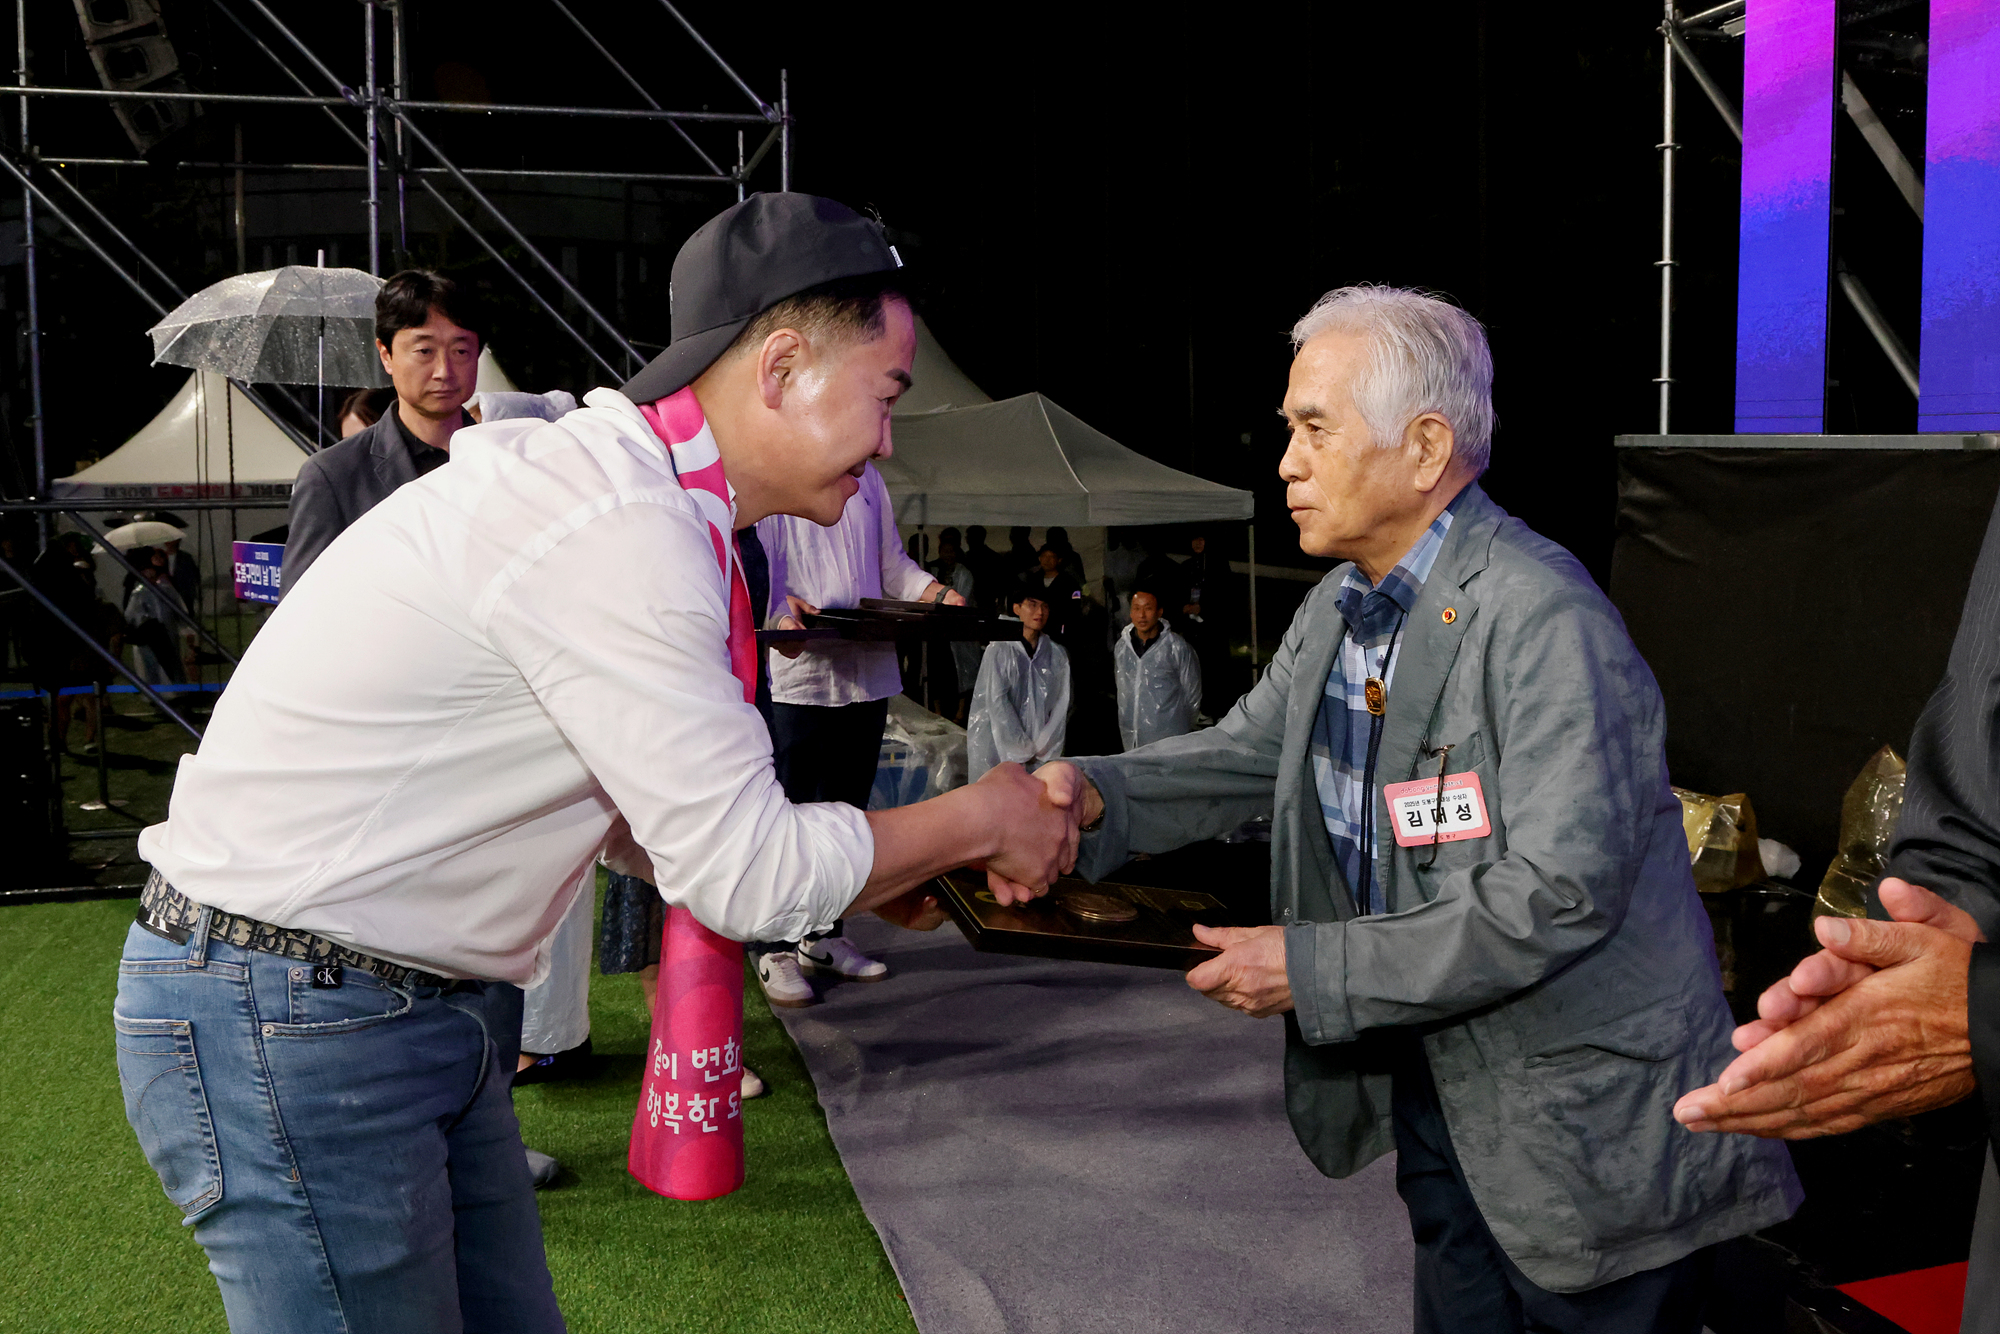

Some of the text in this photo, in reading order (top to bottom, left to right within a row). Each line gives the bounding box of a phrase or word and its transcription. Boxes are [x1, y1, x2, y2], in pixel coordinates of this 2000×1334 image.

[235, 562, 262, 586] 도봉구민의
[262, 565, 269, 586] 날
[1422, 795, 1451, 806] 도봉구대상
[646, 1082, 720, 1135] 행복한
